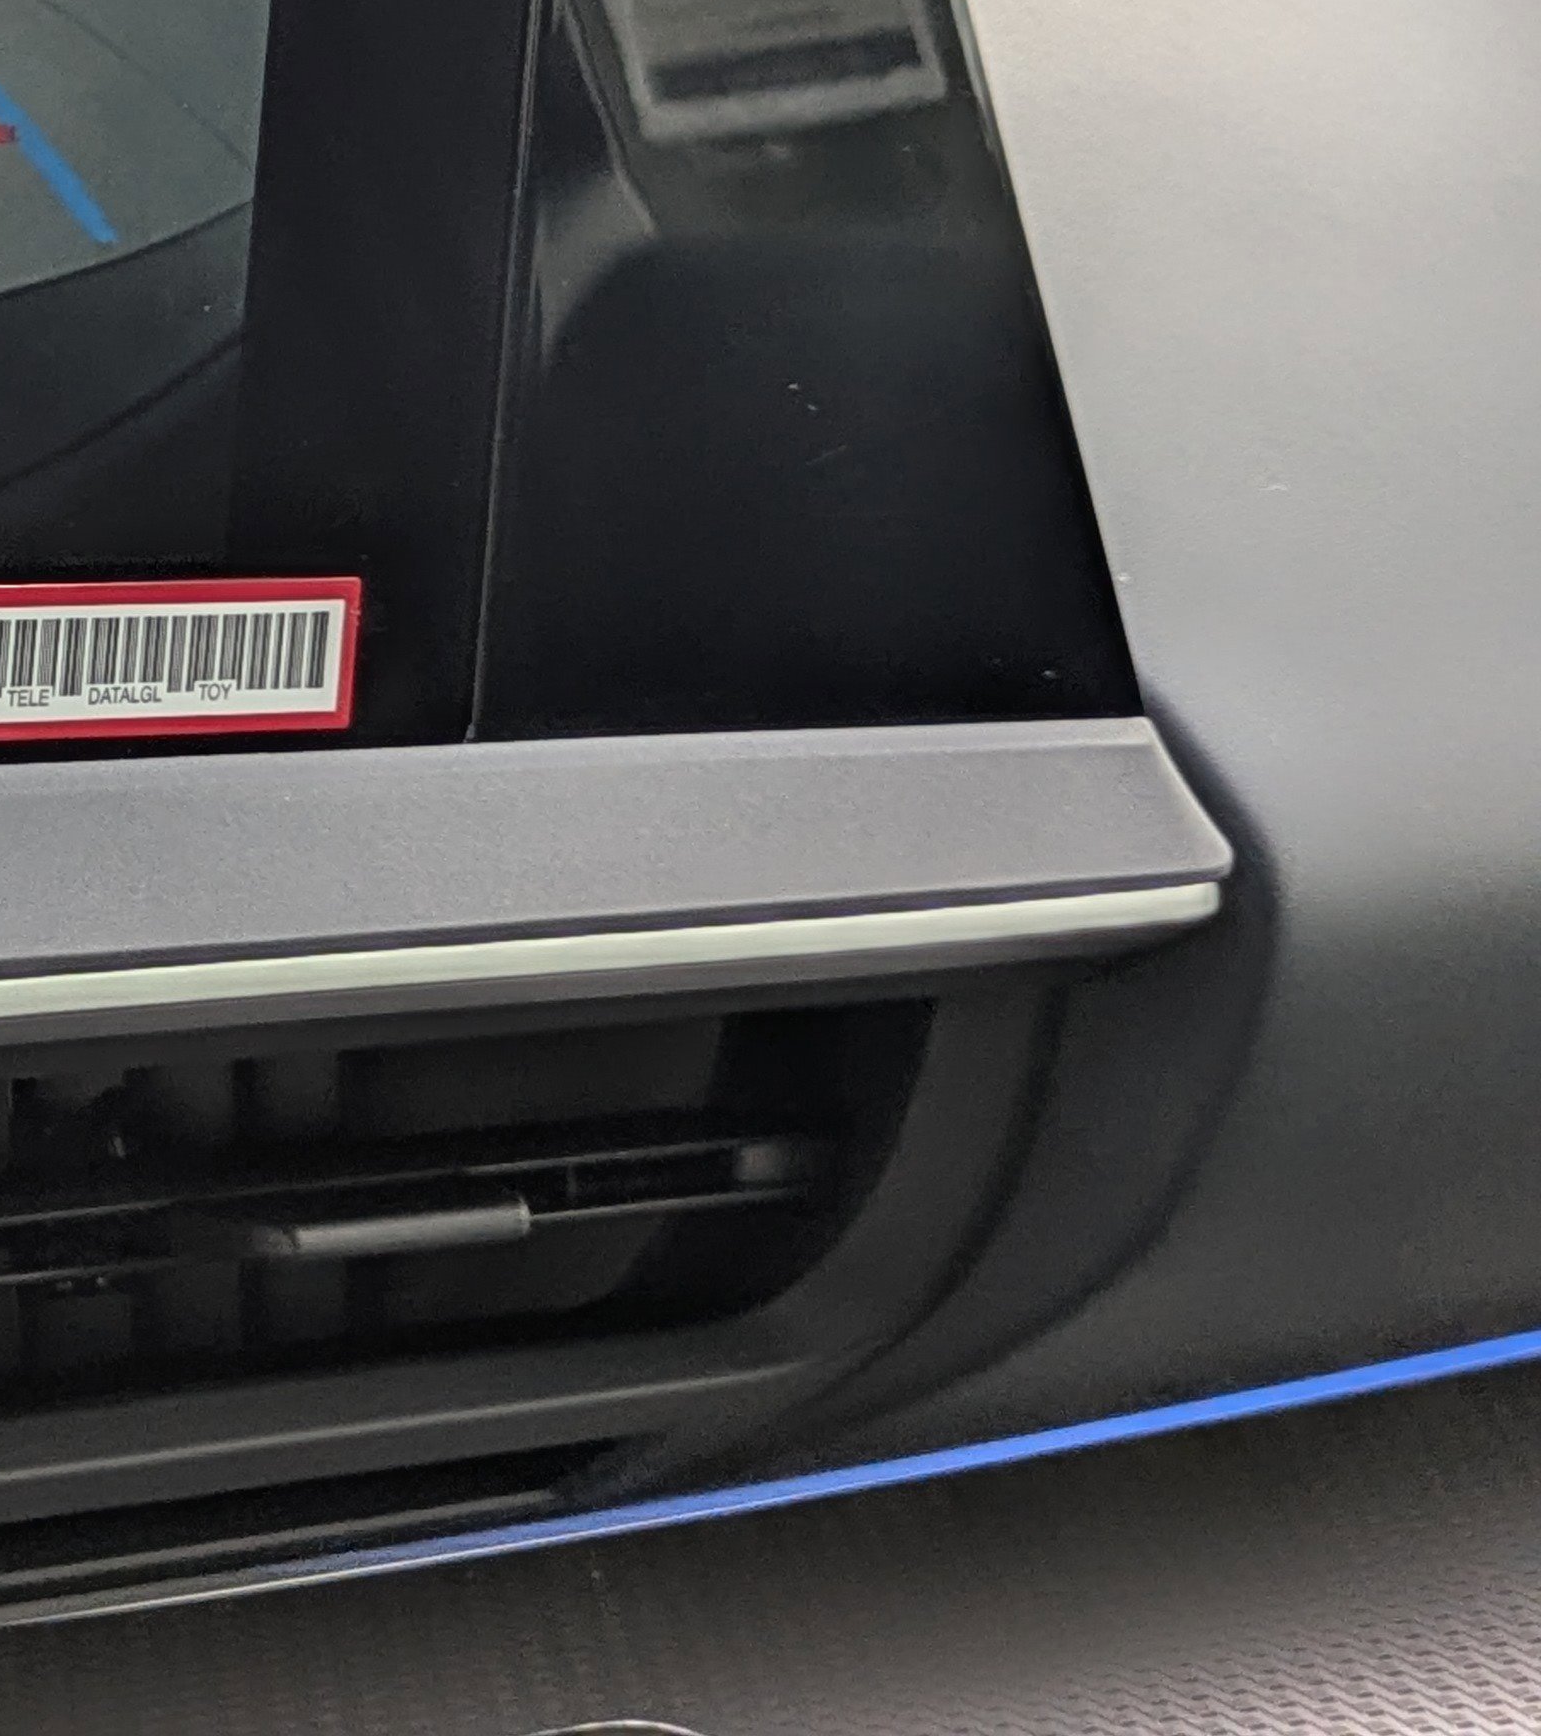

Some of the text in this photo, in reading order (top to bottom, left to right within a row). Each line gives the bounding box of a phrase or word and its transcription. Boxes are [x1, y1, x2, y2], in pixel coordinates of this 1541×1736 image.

[7, 682, 233, 707] TELE DATALGL TOY
